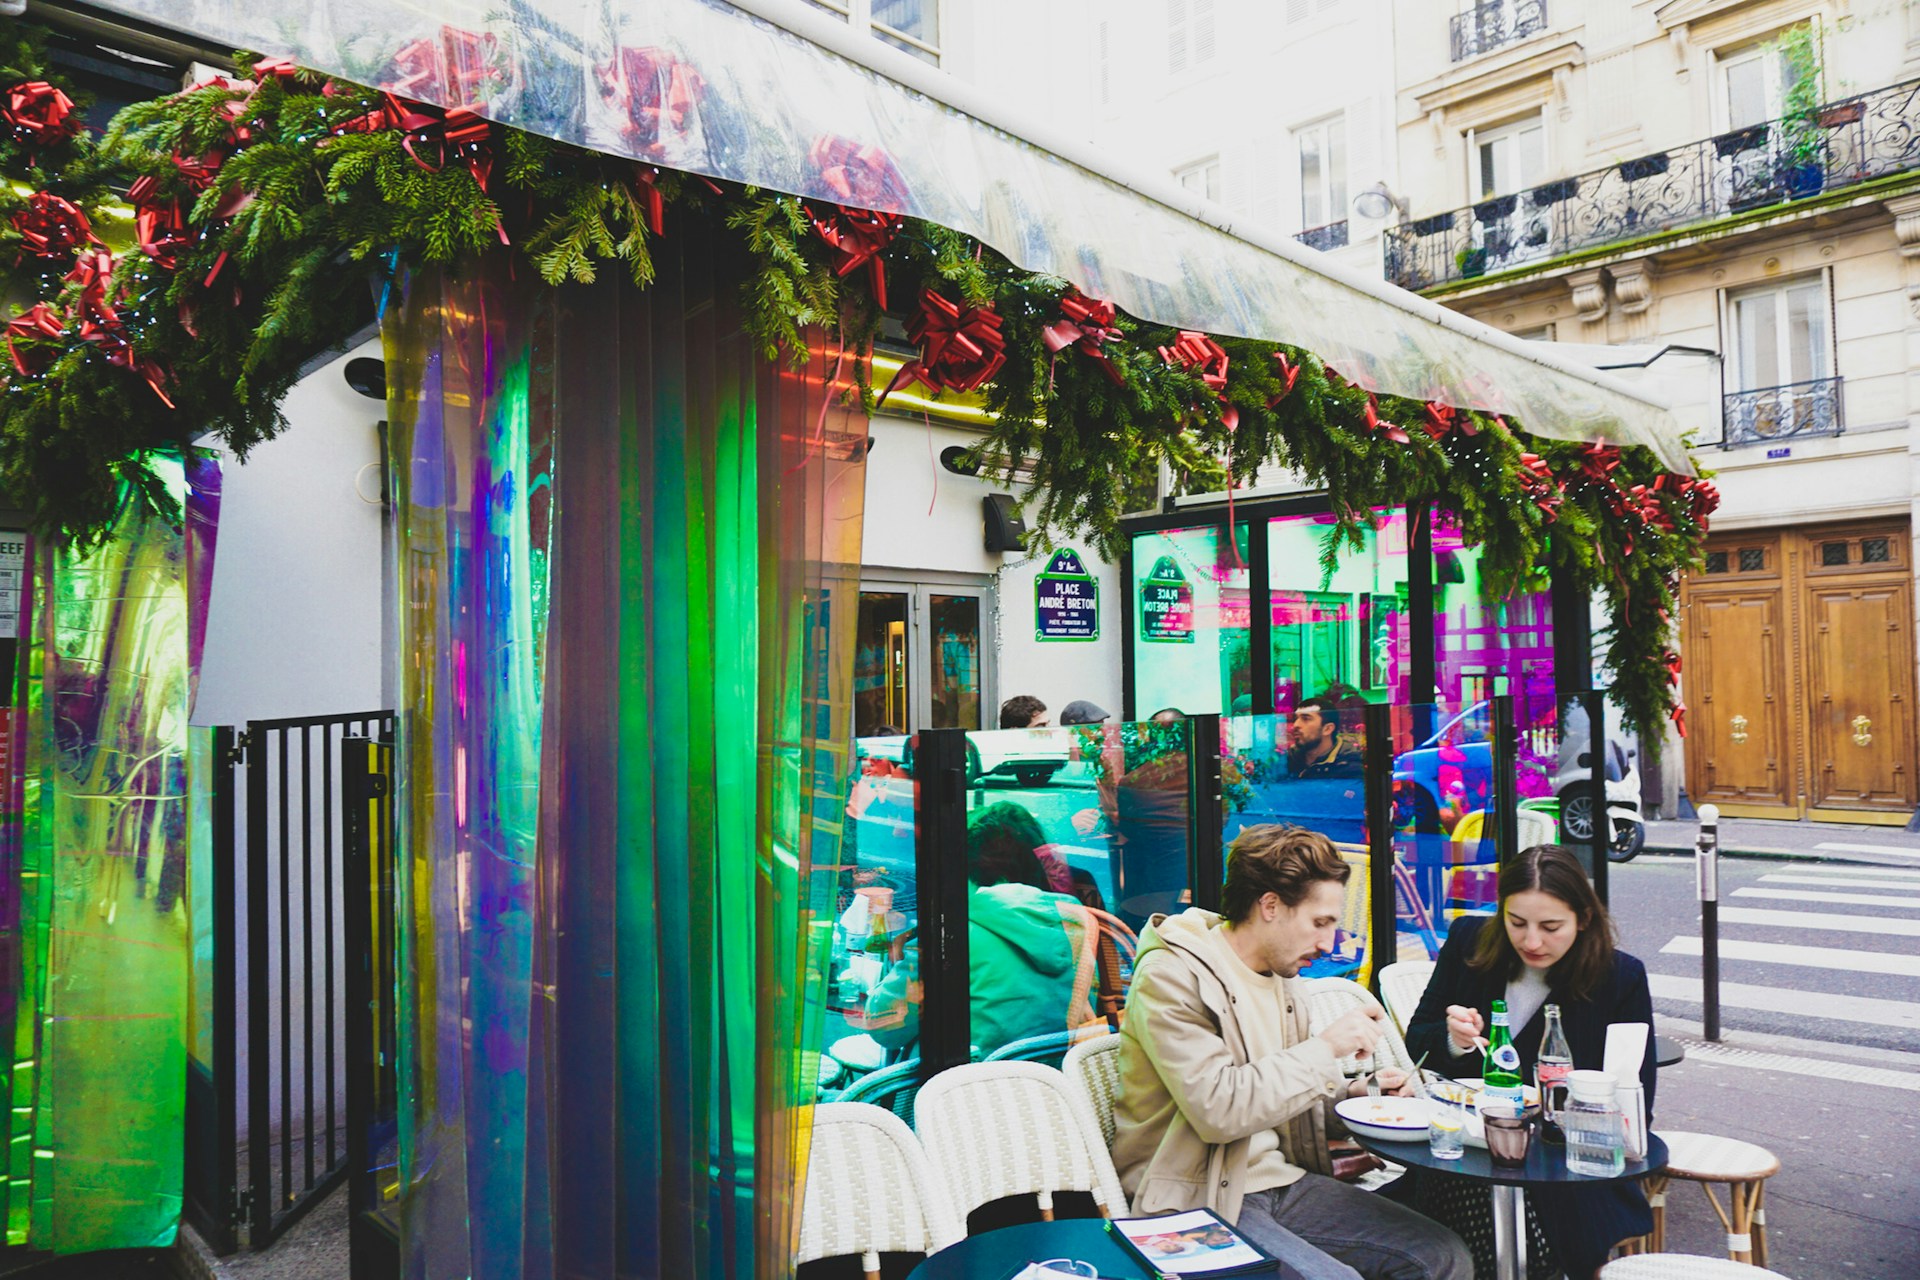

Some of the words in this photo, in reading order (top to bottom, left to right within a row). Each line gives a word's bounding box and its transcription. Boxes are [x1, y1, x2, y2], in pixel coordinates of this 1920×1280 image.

[1055, 583, 1080, 595] PLACE
[1039, 595, 1065, 609] ANDRÉ
[1067, 598, 1096, 610] BRETON
